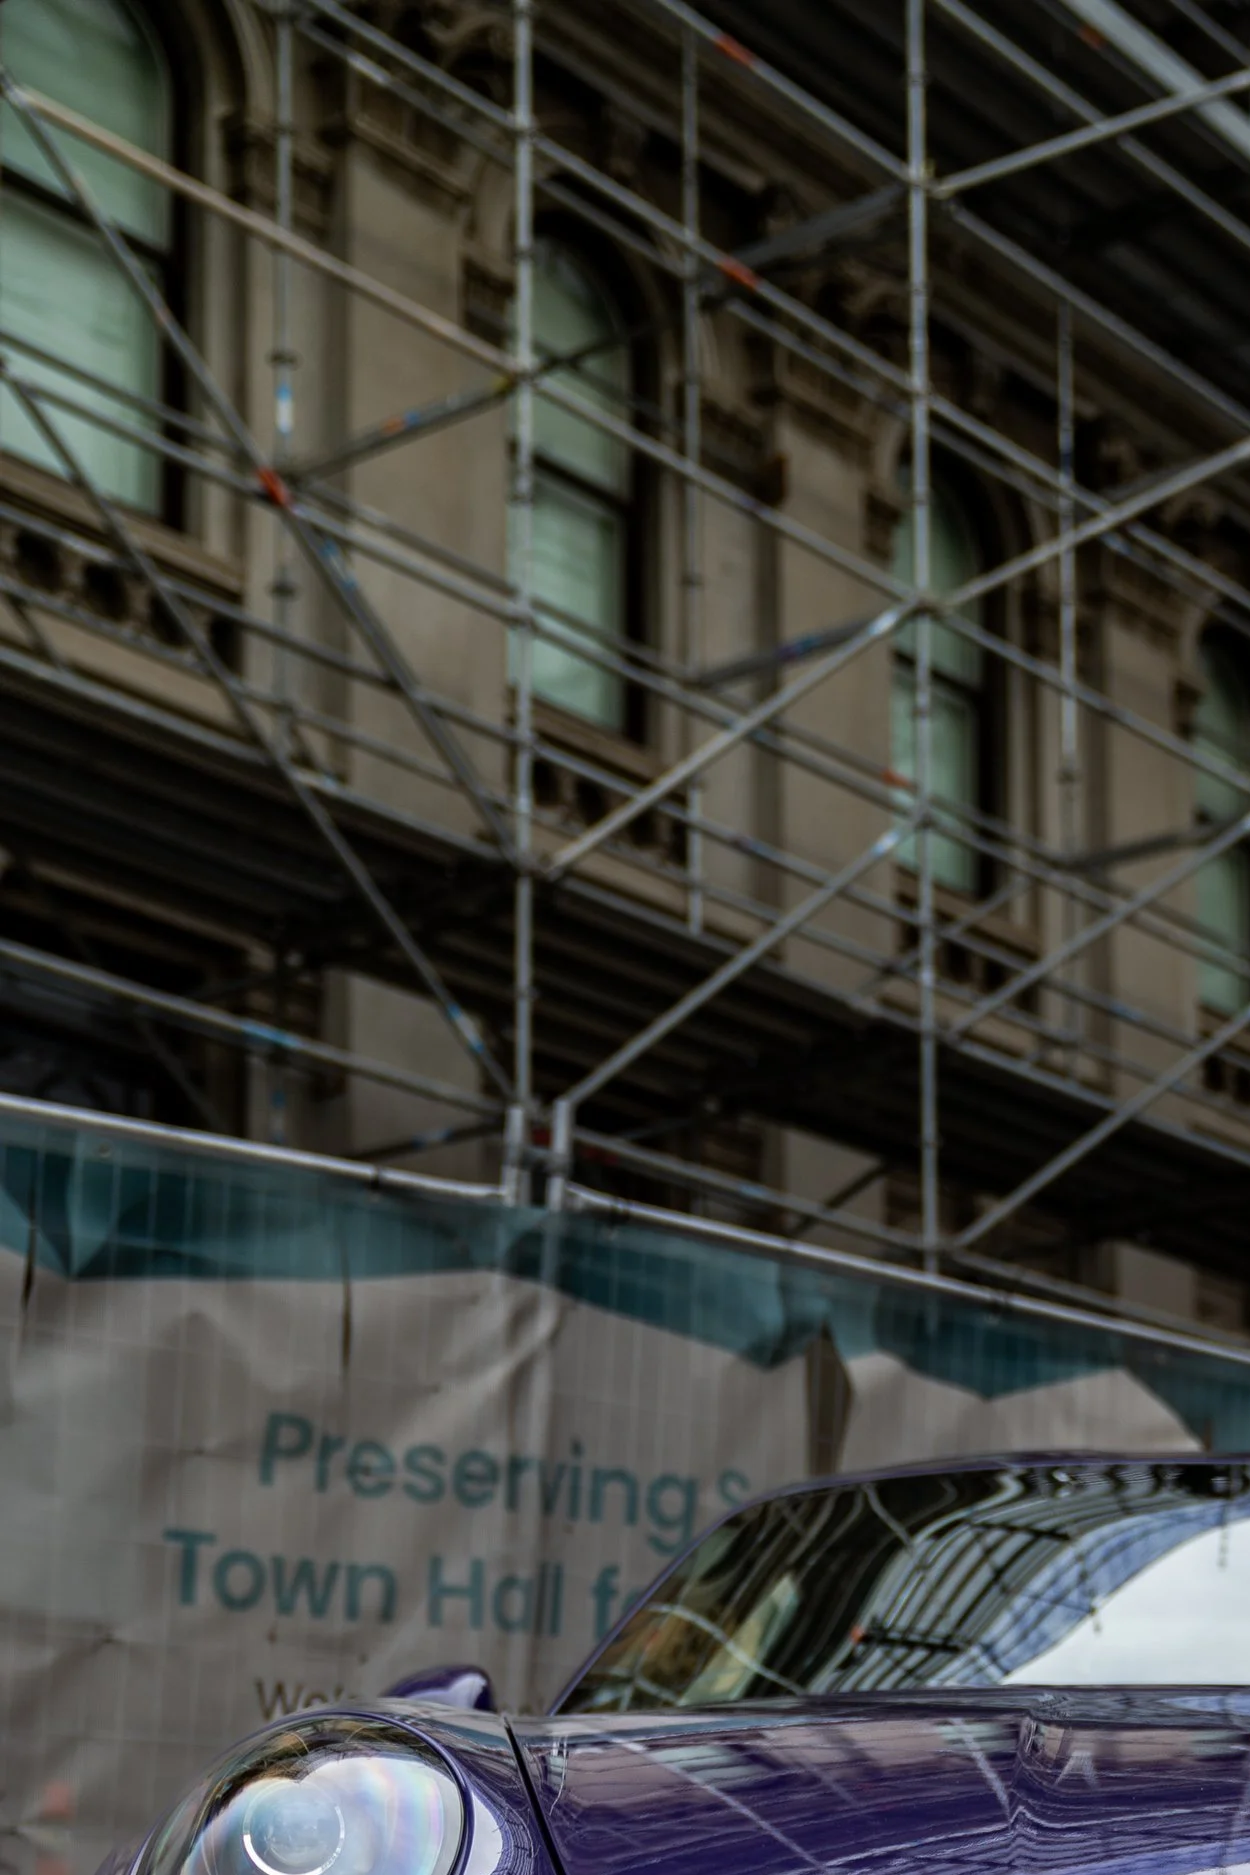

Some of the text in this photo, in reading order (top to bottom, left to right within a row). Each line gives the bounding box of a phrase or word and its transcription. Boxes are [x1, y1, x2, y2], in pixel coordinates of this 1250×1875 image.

[257, 1411, 699, 1557] Preserving
[163, 1526, 398, 1625] Town
[427, 1555, 564, 1637] Hall
